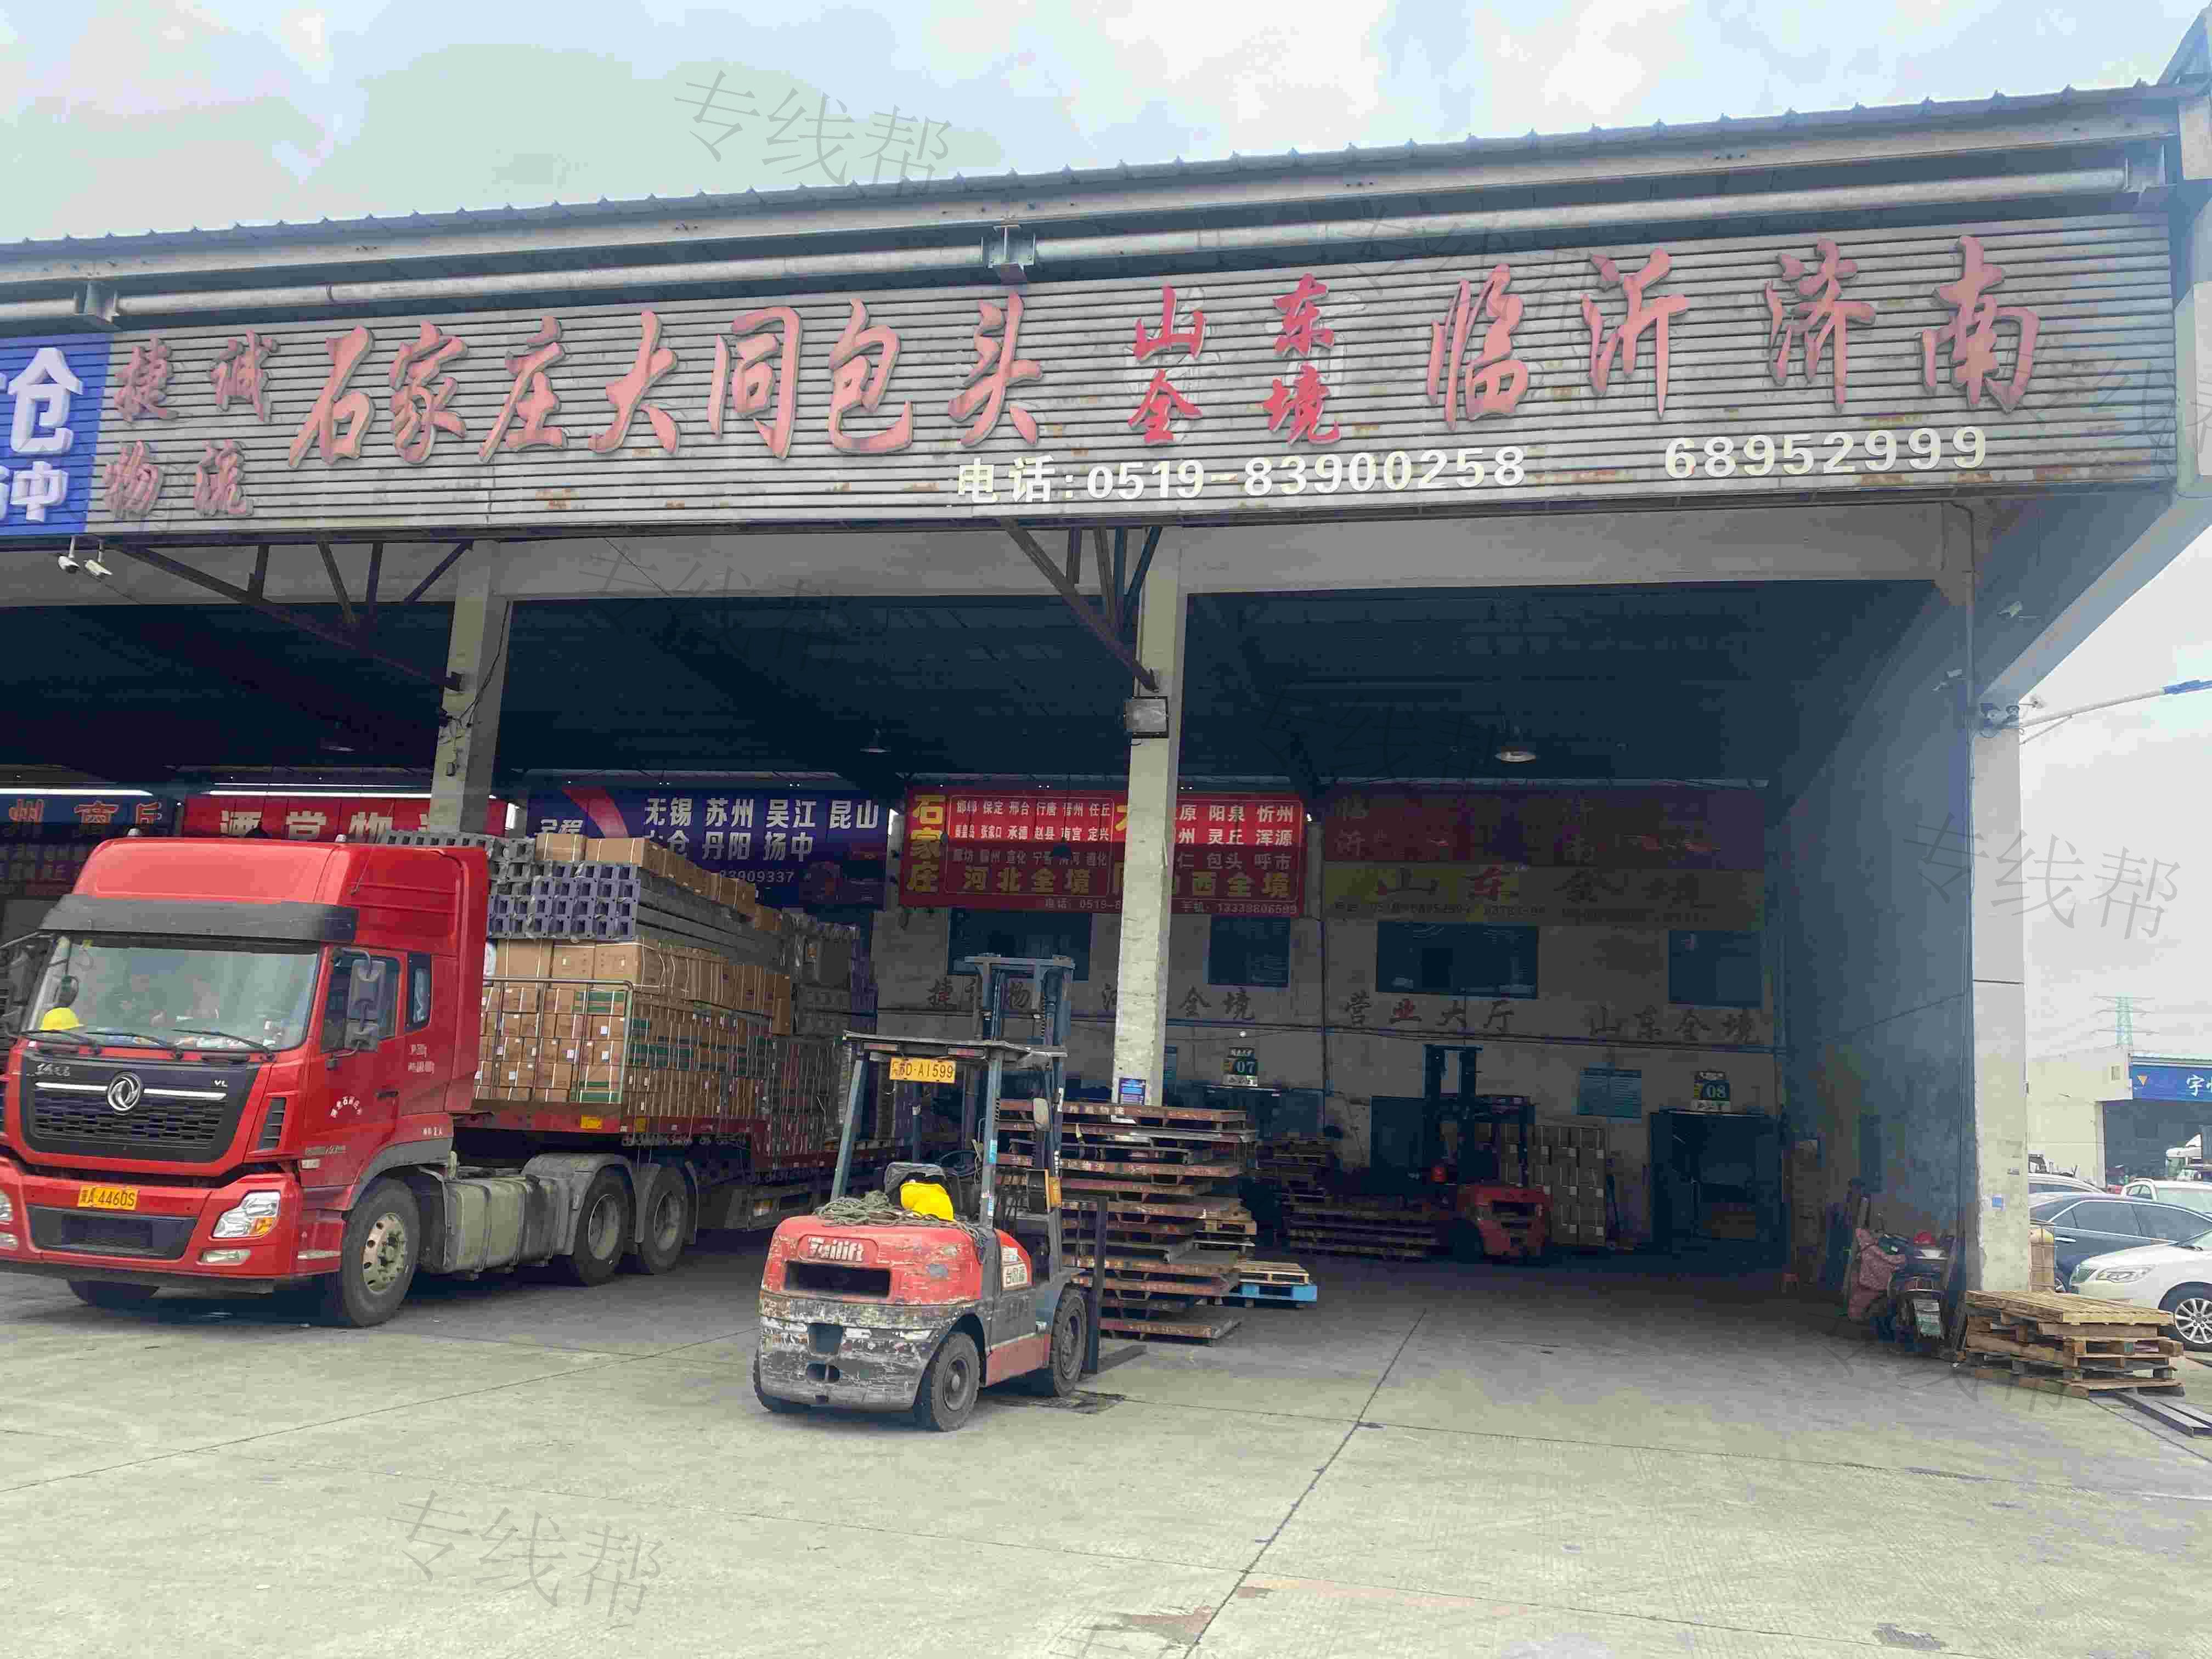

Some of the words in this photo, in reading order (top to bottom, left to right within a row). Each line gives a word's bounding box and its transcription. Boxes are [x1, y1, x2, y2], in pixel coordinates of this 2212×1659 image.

[1132, 272, 1335, 362] 山东
[0, 347, 83, 454] 仓
[1127, 363, 1340, 445] 全境
[1664, 426, 1987, 478] 68952999
[102, 439, 255, 519] 物流
[644, 797, 692, 827] 无锡
[702, 798, 754, 828] 苏州
[765, 799, 816, 828] 吴江
[830, 799, 879, 830] 昆山
[983, 801, 1003, 815] 保定
[1009, 802, 1029, 816] 邢台
[1036, 802, 1056, 817] 行唐
[1089, 803, 1110, 817] 任丘
[1173, 804, 1197, 821] 原
[1209, 805, 1245, 822] 阳泉
[1257, 805, 1294, 823] 忻州
[703, 832, 751, 861] 丹阳
[763, 832, 813, 862] 扬中
[907, 795, 946, 893] 石家庄
[980, 825, 1001, 839] 张家口
[1008, 826, 1028, 840] 承德
[1034, 826, 1054, 841] 赵县
[1088, 827, 1110, 842] 定兴
[1174, 828, 1195, 844] 州
[1208, 828, 1245, 845] 灵丘
[1256, 829, 1293, 847] 浑源
[1206, 853, 1243, 870] 包头
[1255, 853, 1291, 871] 呼市
[1344, 990, 1515, 1032] 营业大厅
[1237, 1061, 1255, 1074] 07
[1707, 1084, 1726, 1098] 08
[2186, 1074, 2212, 1097] 宇
